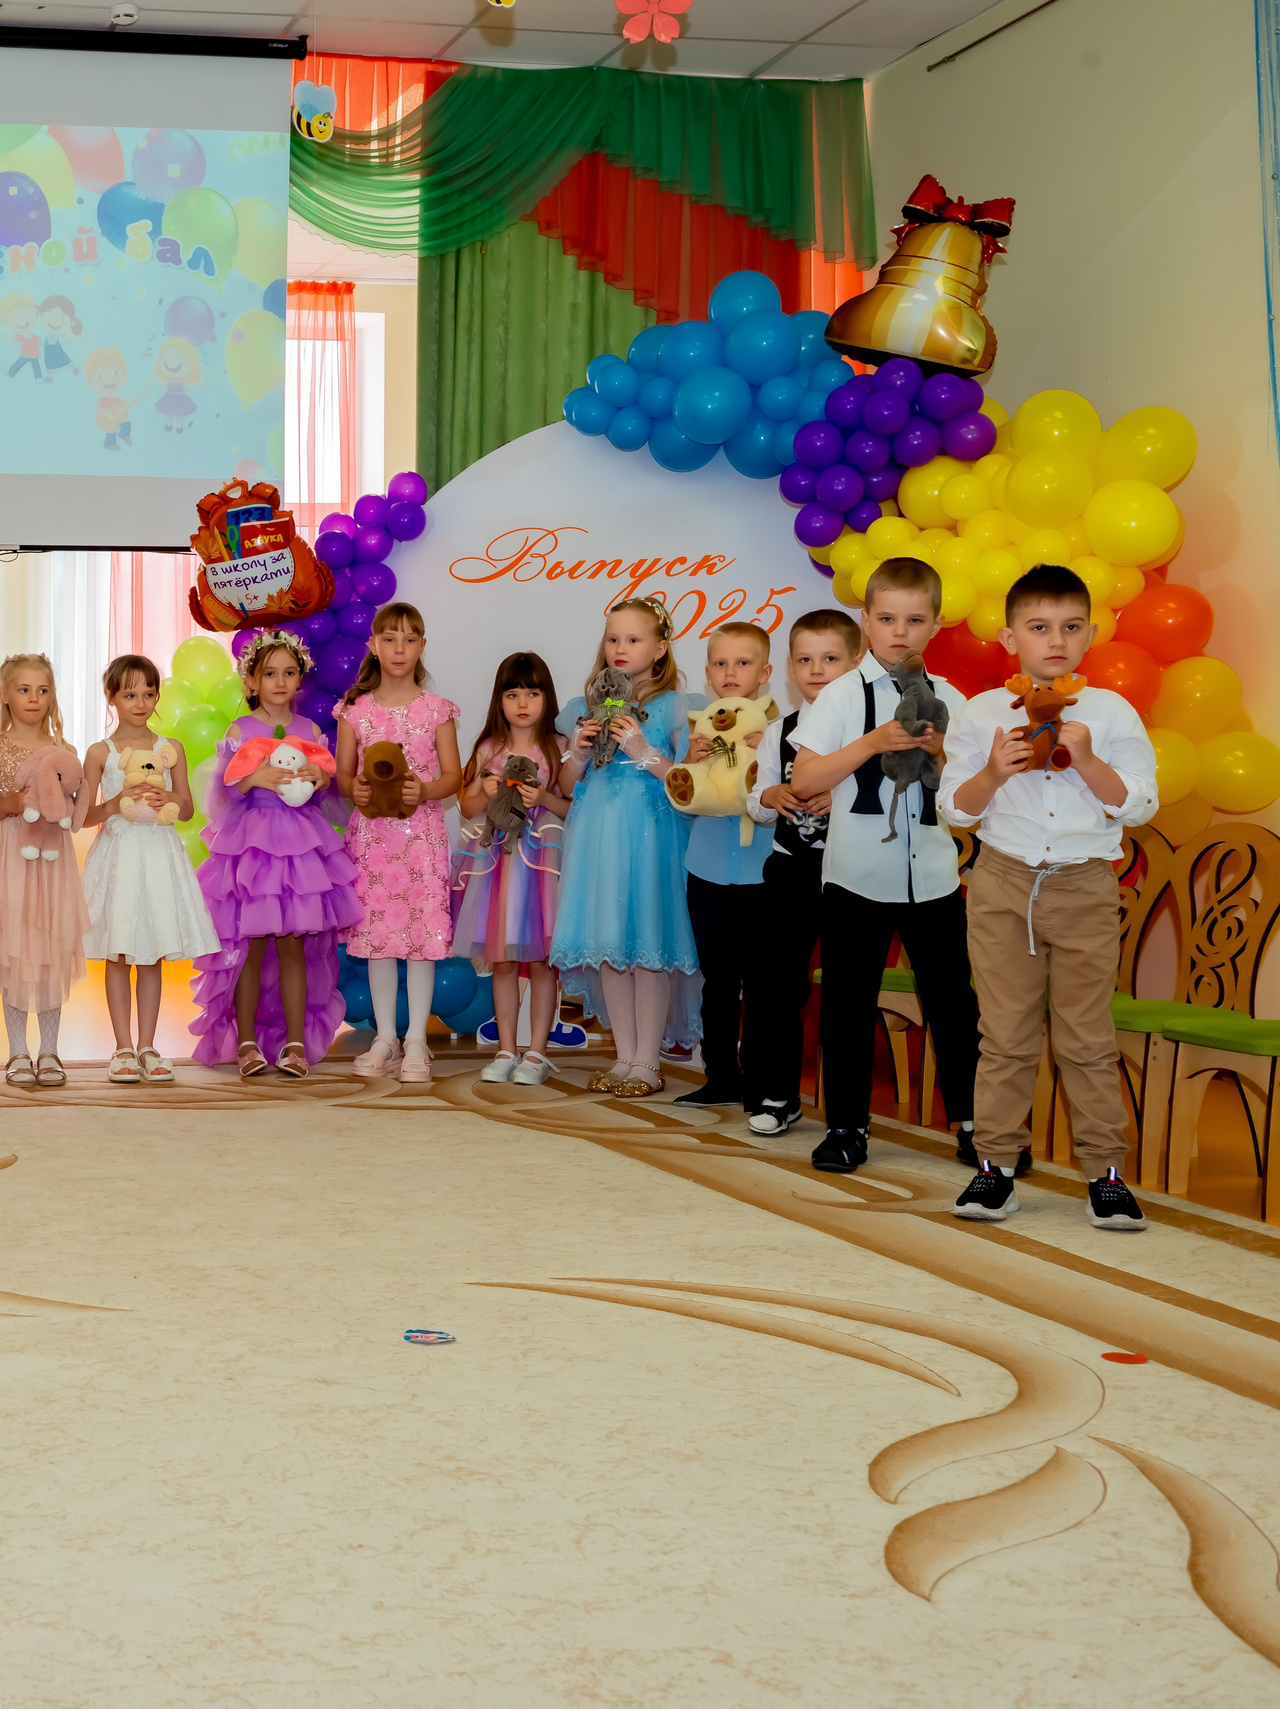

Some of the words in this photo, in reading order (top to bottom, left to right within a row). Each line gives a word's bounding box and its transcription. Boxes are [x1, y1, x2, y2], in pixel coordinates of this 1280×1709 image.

[126, 219, 217, 278] бал
[231, 507, 266, 526] 123
[244, 533, 284, 549] АЗБУКА
[221, 559, 268, 575] школу
[269, 552, 287, 564] за
[449, 526, 736, 618] Выпуск
[213, 566, 291, 591] пятёрками
[244, 593, 260, 605] 5+
[646, 586, 798, 643] 025
